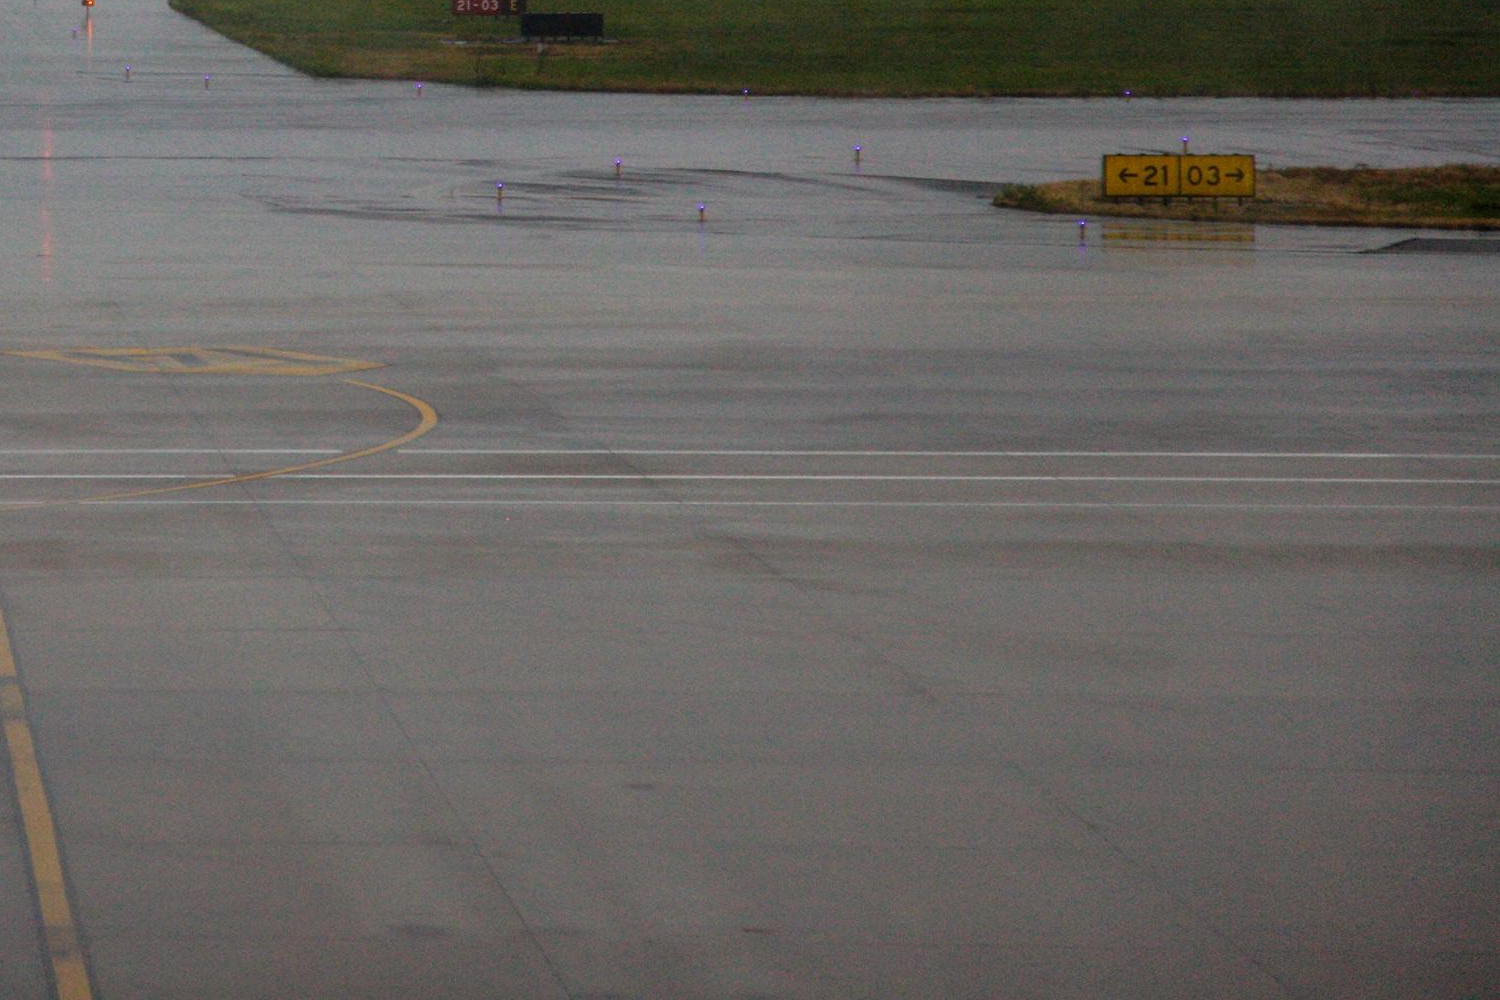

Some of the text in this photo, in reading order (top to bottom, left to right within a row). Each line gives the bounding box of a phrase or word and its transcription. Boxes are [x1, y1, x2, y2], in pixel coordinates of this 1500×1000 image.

[456, 0, 517, 12] 21-03 E
[1143, 165, 1221, 186] 21 03
